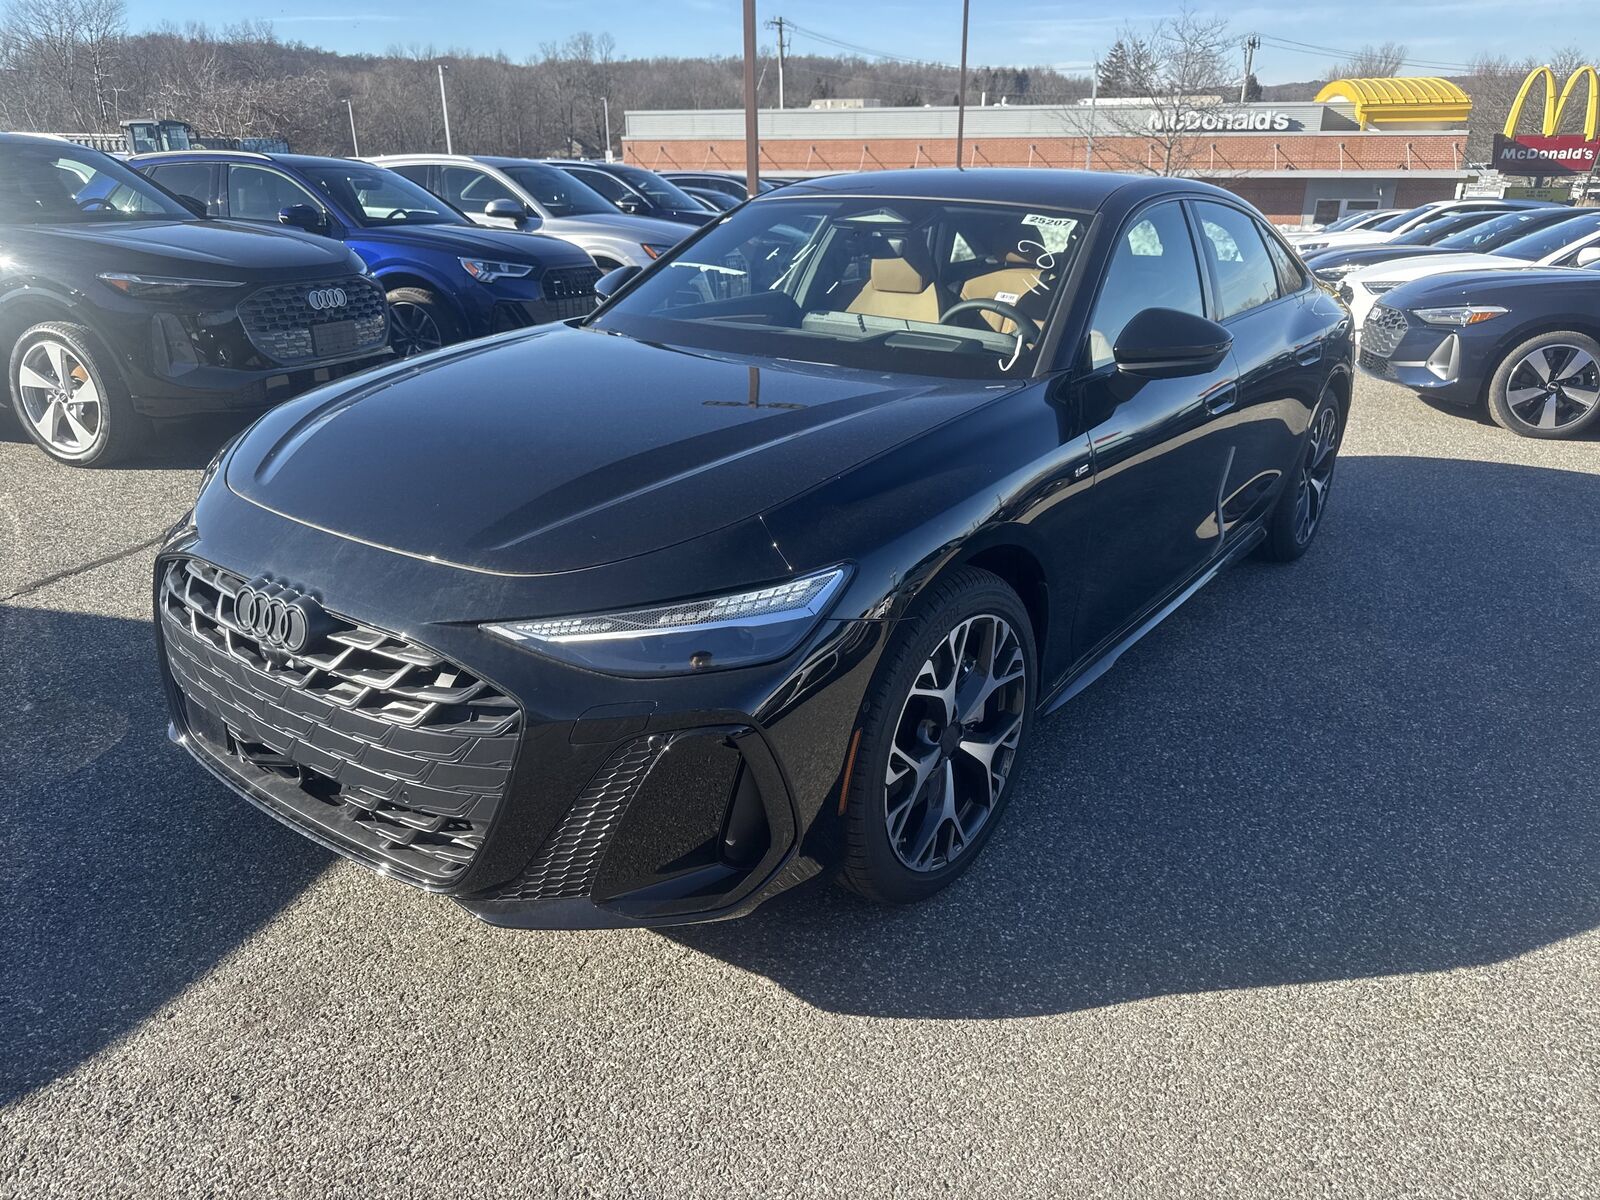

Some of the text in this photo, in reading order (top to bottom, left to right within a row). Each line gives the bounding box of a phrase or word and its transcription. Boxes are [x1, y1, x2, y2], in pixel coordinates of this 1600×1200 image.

[1150, 110, 1289, 130] McDonald's
[1500, 147, 1594, 160] McDonald's
[1029, 215, 1071, 226] 25207
